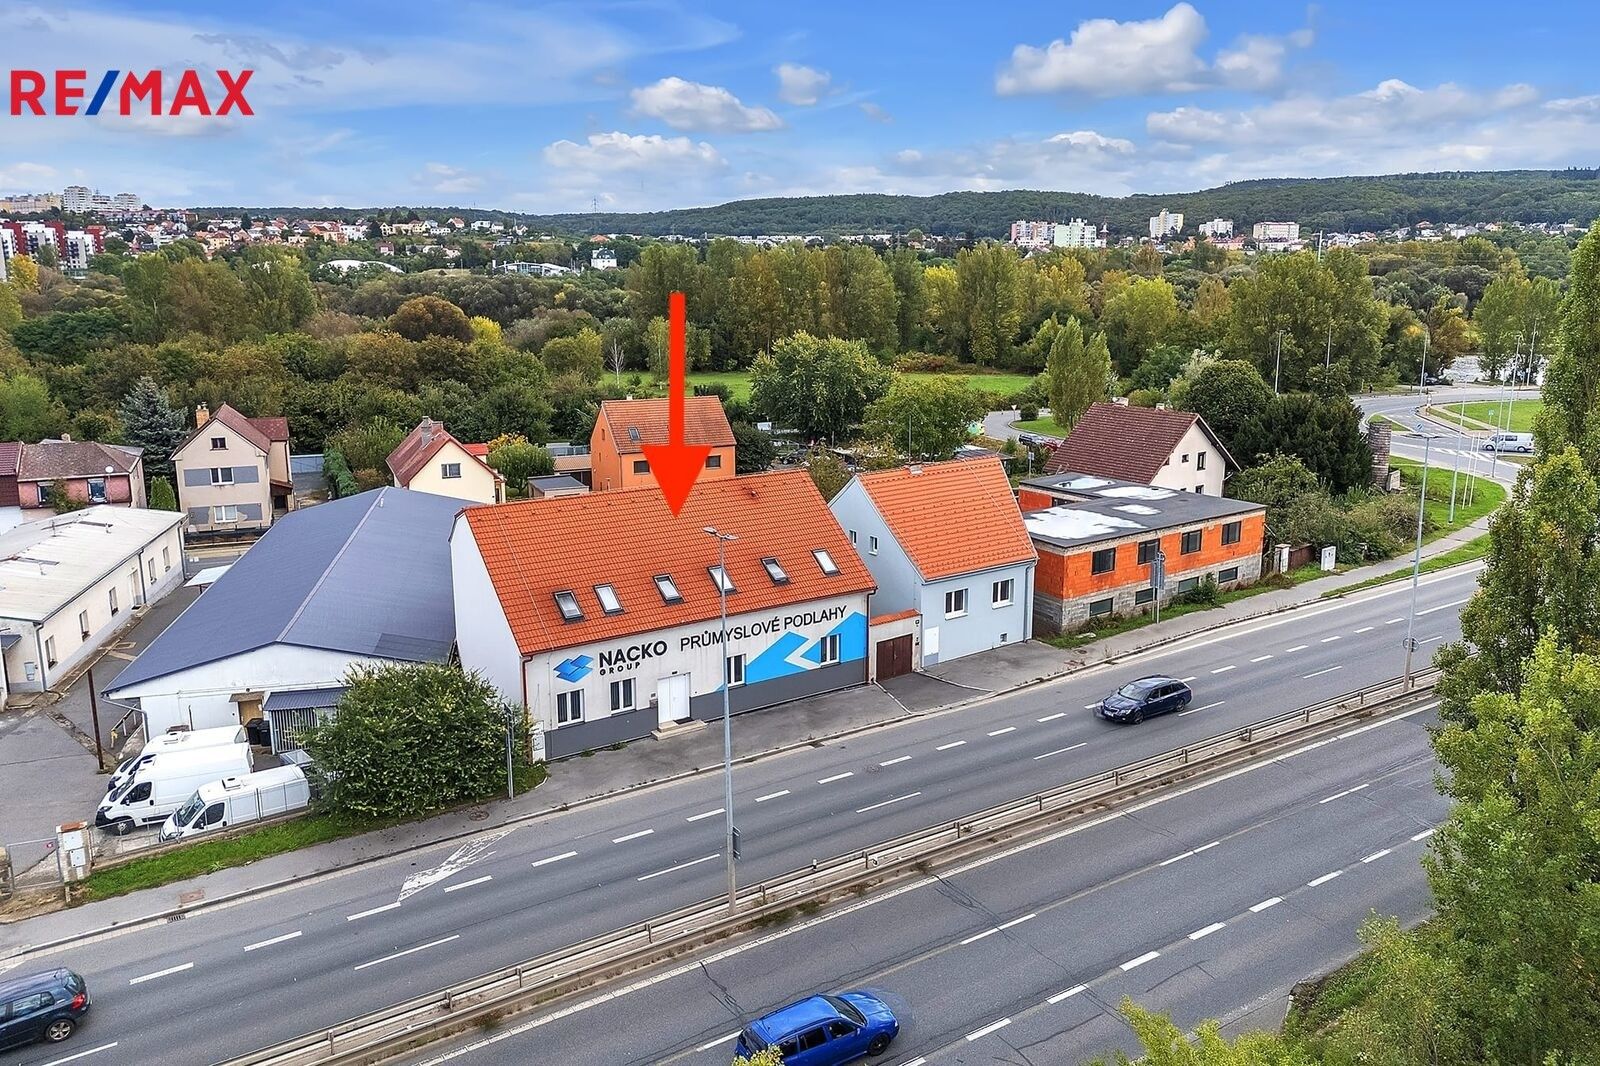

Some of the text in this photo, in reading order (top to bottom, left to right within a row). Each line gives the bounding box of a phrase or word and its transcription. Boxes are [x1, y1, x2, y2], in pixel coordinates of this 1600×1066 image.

[680, 605, 847, 652] PRŮMYSLOVÉ PODLAHY
[599, 640, 668, 668] NACKO
[599, 661, 641, 676] GROUP
